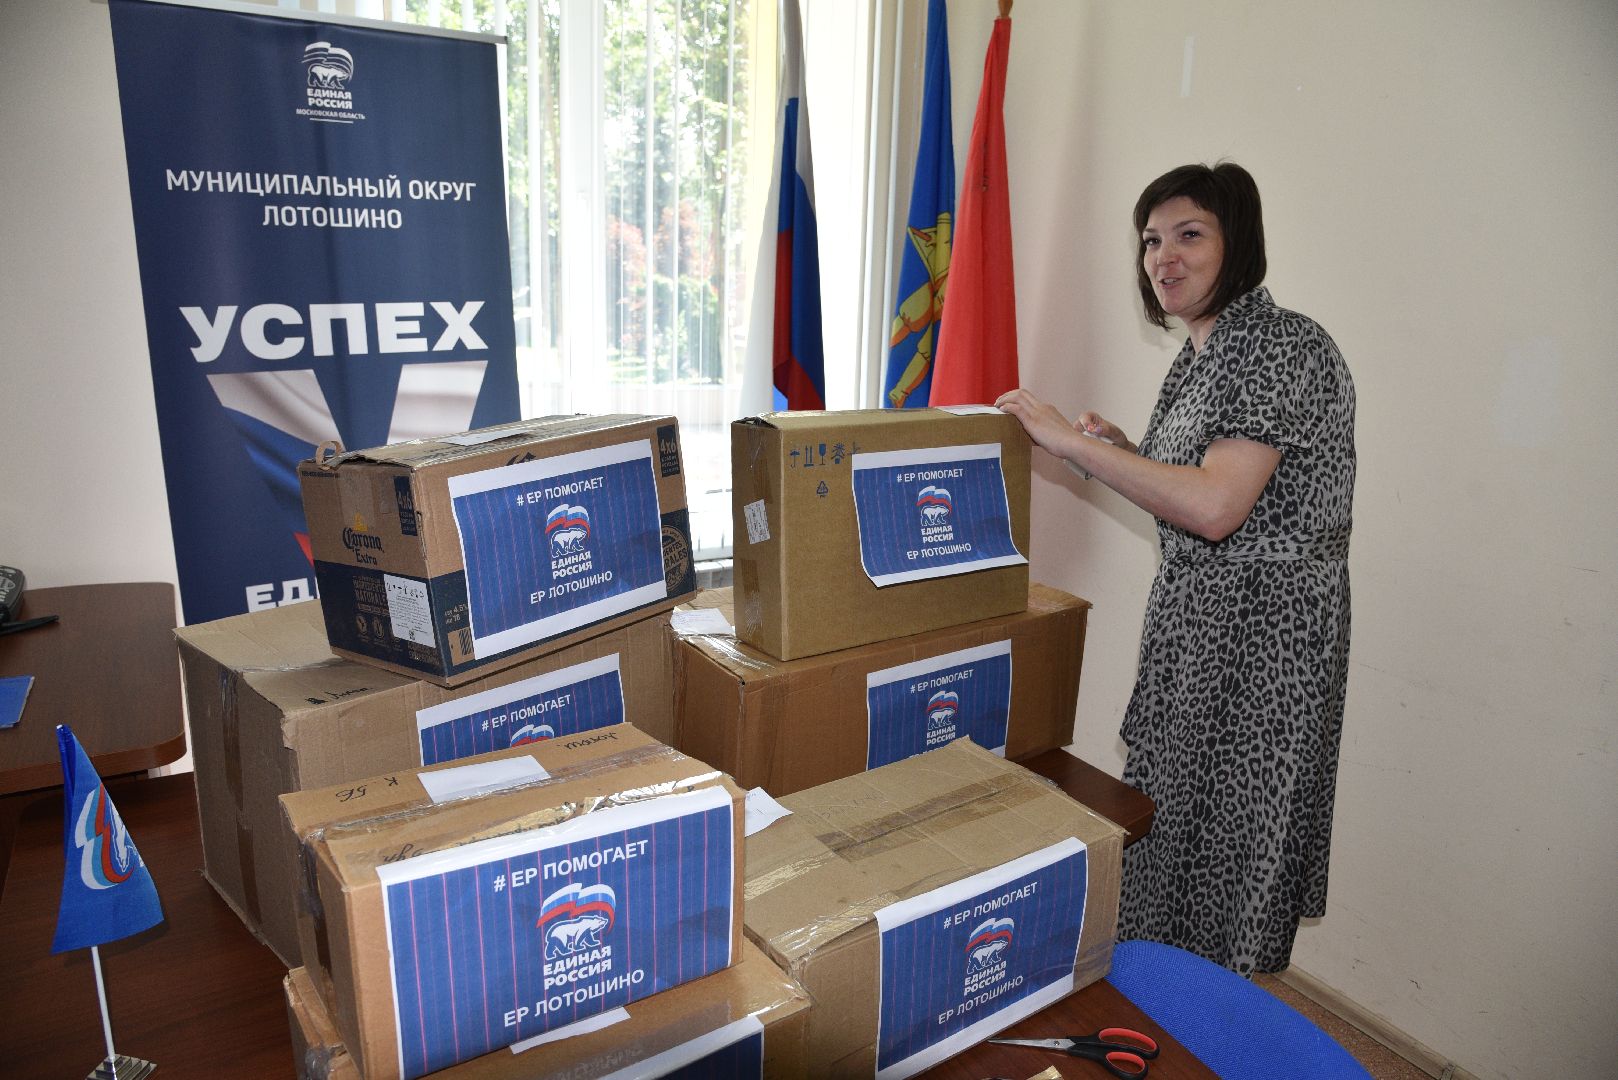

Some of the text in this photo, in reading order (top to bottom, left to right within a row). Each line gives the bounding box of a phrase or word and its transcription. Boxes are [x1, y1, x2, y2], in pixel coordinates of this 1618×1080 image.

[307, 88, 352, 100] ЕДИНАЯ
[308, 97, 352, 109] РОССИЯ
[296, 108, 365, 119] МОСКОВСКАЯ ОБЛАСТЬ
[166, 169, 476, 203] МУНИЦИПАЛЬНЫЙ ОКРУГ
[262, 206, 402, 230] ЛОТОШИНО
[179, 301, 488, 363] УСПЕХ
[896, 467, 964, 483] # ЕР ПОМОГАЕТ
[516, 476, 604, 506] # ЕР ПОМОГАЕТ
[343, 527, 384, 553] Corona
[921, 524, 953, 536] ЕДИНАЯ
[922, 531, 954, 544] РОССИЯ
[356, 549, 378, 565] Extra
[551, 551, 591, 570] ЕДИНАЯ
[906, 543, 972, 561] ЕР ЛОТОШИНО
[552, 561, 592, 580] РОССИЯ
[246, 576, 320, 612] ЕД
[530, 571, 613, 605] ЕР ЛОТОШИНО
[910, 669, 974, 694] # ЕР ПОМОГАЕТ
[481, 694, 571, 732] # ЕР ПОМОГАЕТ
[926, 724, 956, 738] ЕДИНАЯ
[926, 731, 956, 745] РОССИЯ
[493, 840, 649, 892] # ЕР ПОМОГАЕТ
[943, 882, 1037, 929] # ЕР ПОМОГАЕТ
[543, 946, 612, 976] ЕДИНАЯ
[964, 961, 1007, 986] ЕДИНАЯ
[543, 958, 612, 990] РОССИЯ
[964, 969, 1007, 996] РОССИЯ
[504, 969, 645, 1028] ЕР ЛОТОШИНО
[938, 975, 1023, 1025] ЕР ЛОТОШИНО
